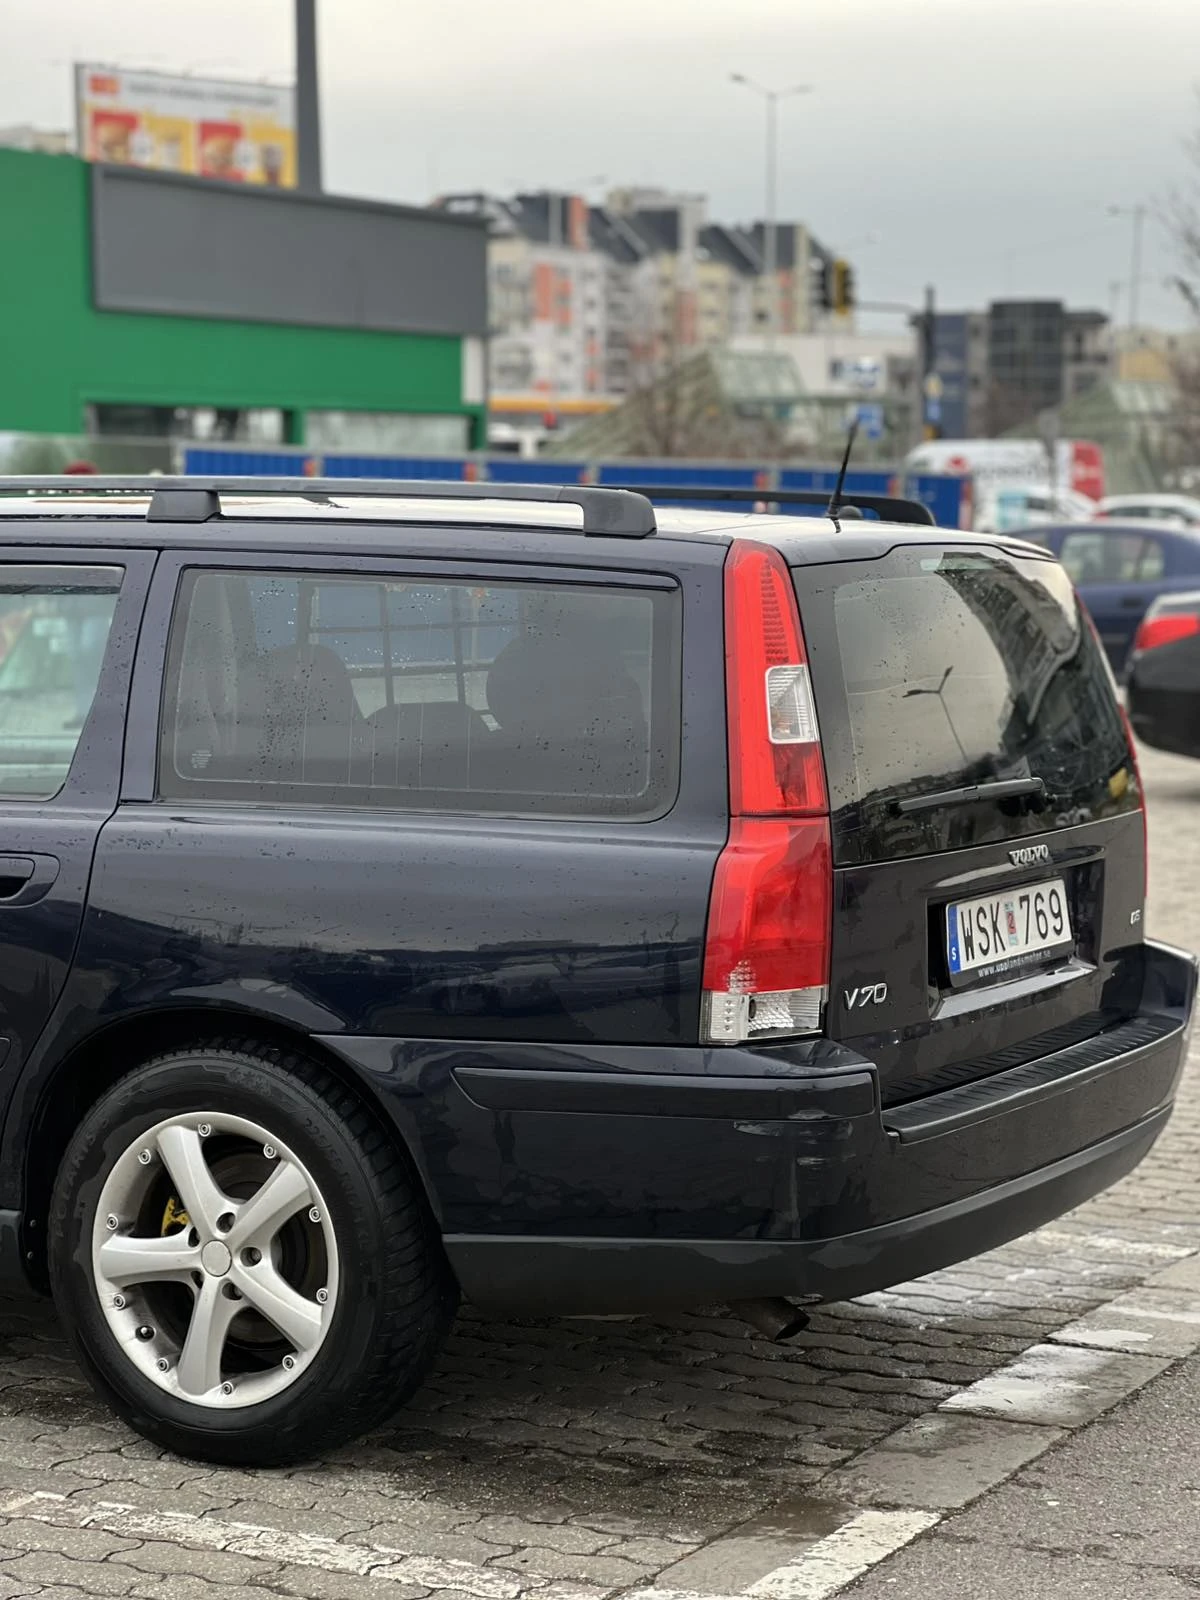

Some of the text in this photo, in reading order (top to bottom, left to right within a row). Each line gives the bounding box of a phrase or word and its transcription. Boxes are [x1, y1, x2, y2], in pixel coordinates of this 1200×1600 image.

[1009, 844, 1049, 866] VOLVO
[960, 888, 1064, 963] WSK 769
[951, 947, 957, 961] S
[844, 982, 888, 1010] V70
